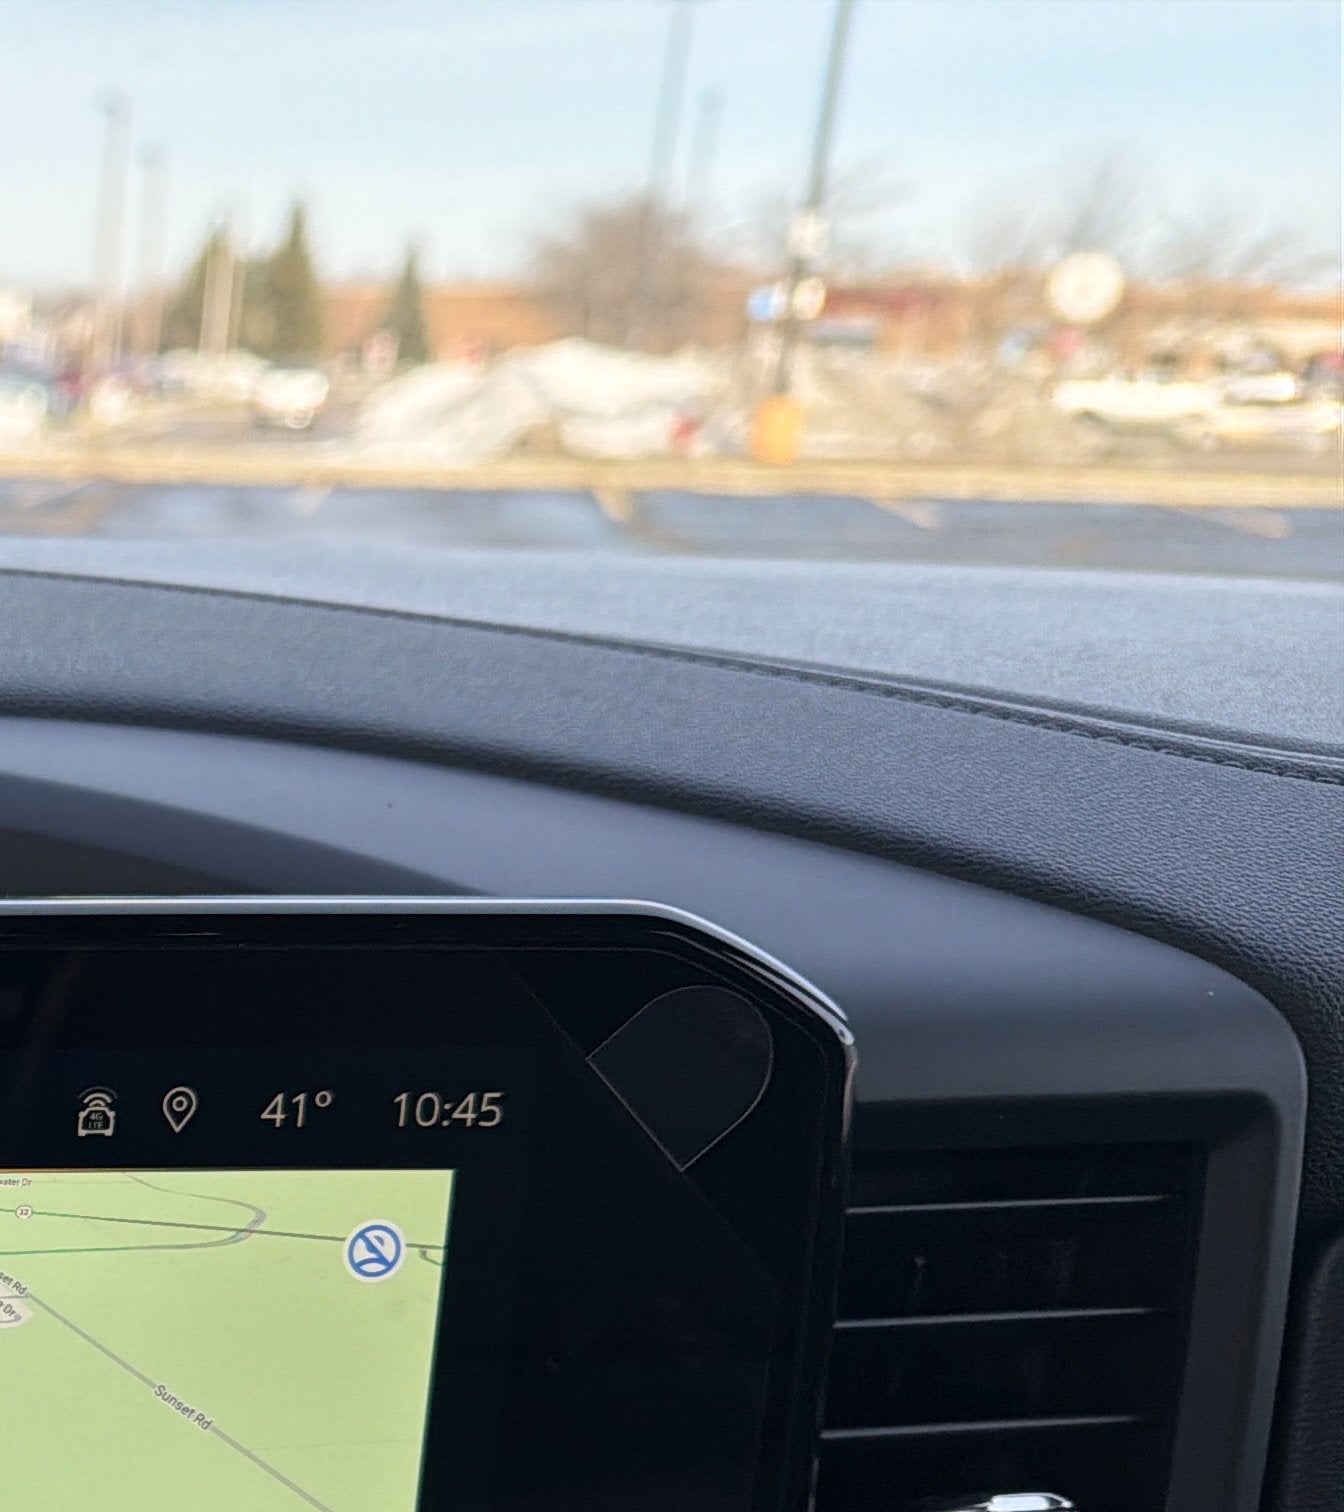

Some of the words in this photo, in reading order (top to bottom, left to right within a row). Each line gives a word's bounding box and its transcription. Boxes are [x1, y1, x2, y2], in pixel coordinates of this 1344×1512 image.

[260, 1090, 333, 1128] 41°
[392, 1091, 504, 1128] 10:45
[21, 1177, 33, 1187] Dr
[12, 1280, 28, 1295] Rd
[2, 1304, 16, 1319] Dr
[154, 1384, 196, 1419] Sunset
[192, 1412, 214, 1431] Rd
